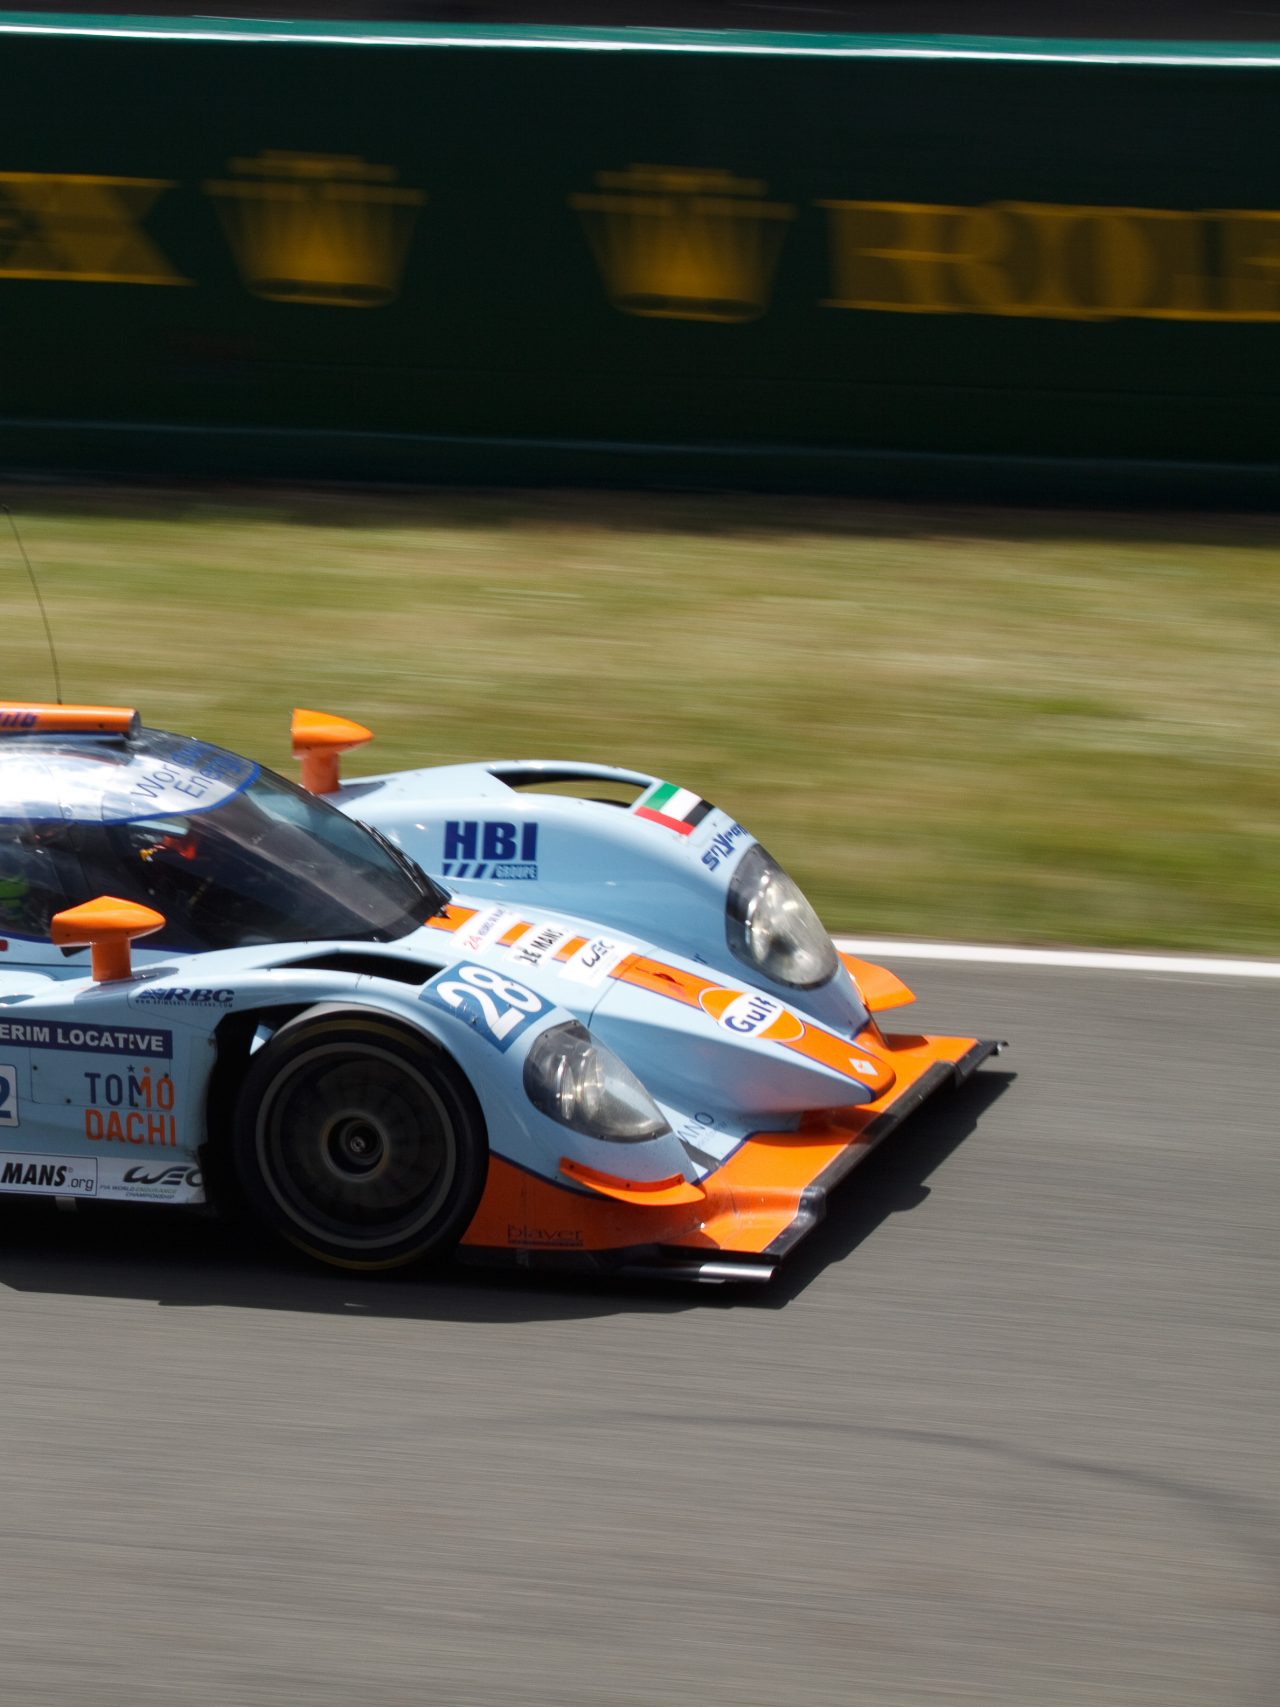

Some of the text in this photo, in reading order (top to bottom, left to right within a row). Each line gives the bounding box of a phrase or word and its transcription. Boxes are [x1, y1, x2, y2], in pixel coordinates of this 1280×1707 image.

[812, 199, 1280, 323] ROLE
[443, 821, 538, 861] HBI
[436, 966, 543, 1041] 28
[724, 995, 777, 1035] Gulf
[57, 1028, 164, 1051] LOCATIVE
[85, 1109, 176, 1147] DACHI
[1, 1162, 68, 1187] MANS
